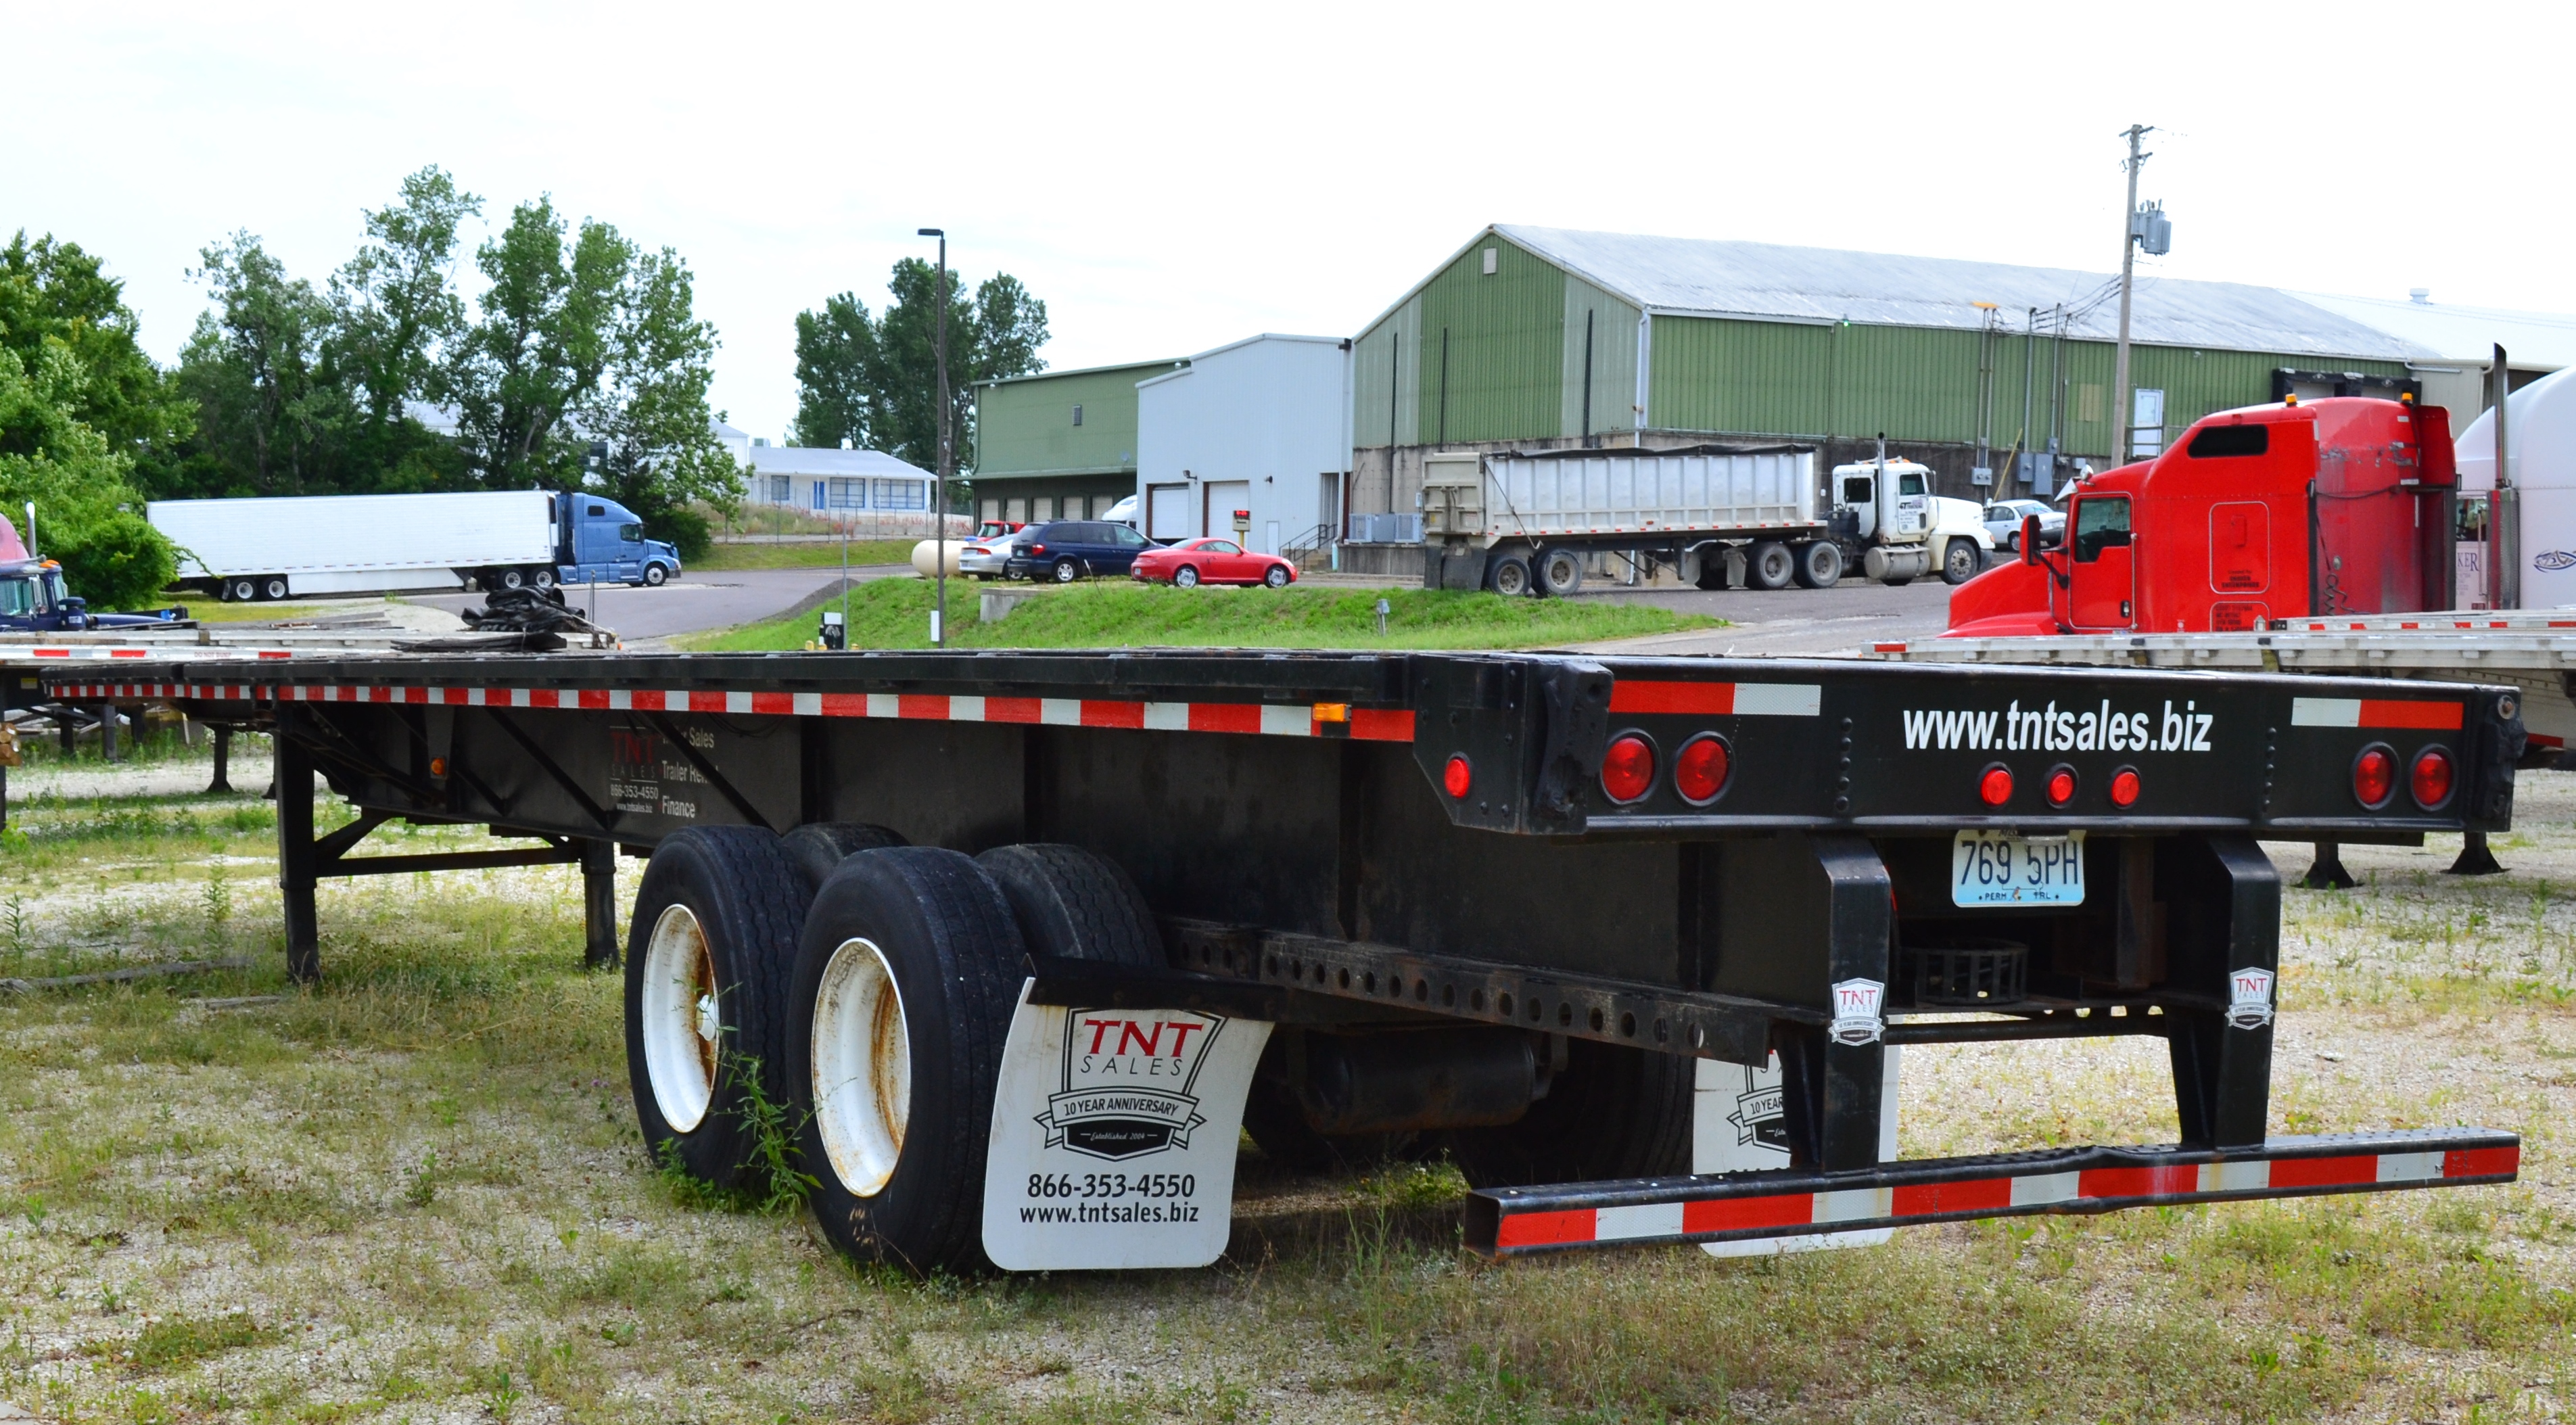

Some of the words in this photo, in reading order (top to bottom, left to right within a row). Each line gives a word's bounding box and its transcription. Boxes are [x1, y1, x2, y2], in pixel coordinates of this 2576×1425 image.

[1903, 699, 2214, 752] www.tntsales.biz
[611, 731, 661, 765] TNT
[689, 727, 714, 748] Sales
[611, 765, 655, 778] SALES
[662, 760, 687, 782] Trailer
[610, 785, 658, 799] 866-353-4550
[662, 795, 696, 818] Finance
[1961, 840, 2011, 885] 769
[2027, 841, 2079, 885] 5PH
[1985, 892, 2007, 901] PERM
[2033, 891, 2051, 900] TRL
[2236, 978, 2267, 991] TNT
[1839, 989, 1876, 1005] TNT
[1840, 1004, 1873, 1013] SALES
[1083, 1019, 1204, 1058] TNT
[1080, 1055, 1183, 1076] SALES
[1064, 1102, 1077, 1117] 10
[1077, 1098, 1106, 1113] YEAR
[1106, 1097, 1179, 1117] ANNIVERSARY
[1750, 1101, 1760, 1115] 10
[1091, 1132, 1127, 1141] Established
[1027, 1173, 1196, 1198] 866-353-4550
[1020, 1201, 1199, 1223] www.tntsales.biz
